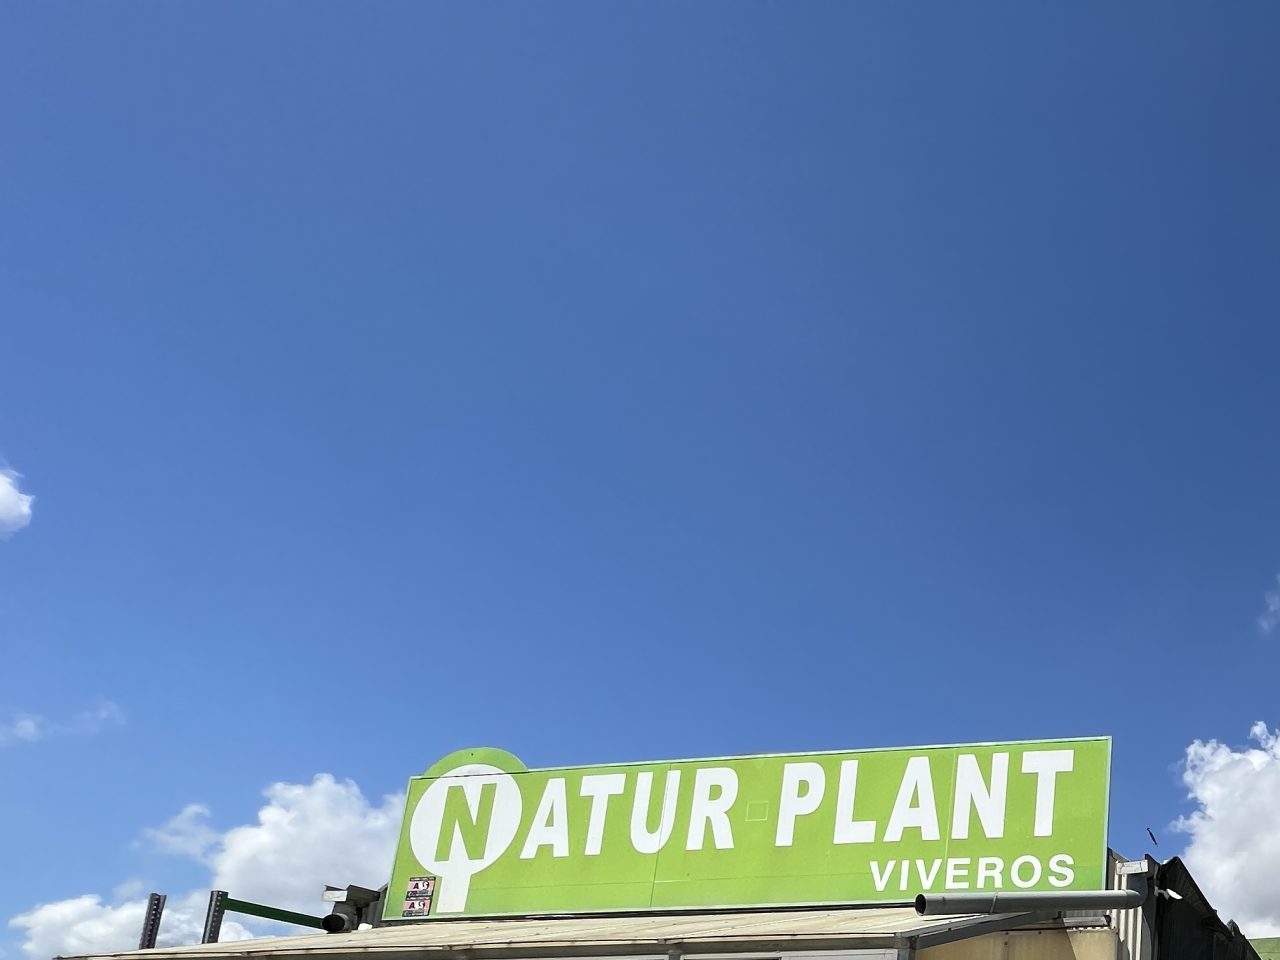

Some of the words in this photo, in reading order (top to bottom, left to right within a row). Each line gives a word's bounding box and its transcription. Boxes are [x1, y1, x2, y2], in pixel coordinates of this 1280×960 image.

[434, 766, 739, 862] NATUR
[775, 749, 1075, 847] PLANT
[869, 853, 1076, 892] VIVEROS
